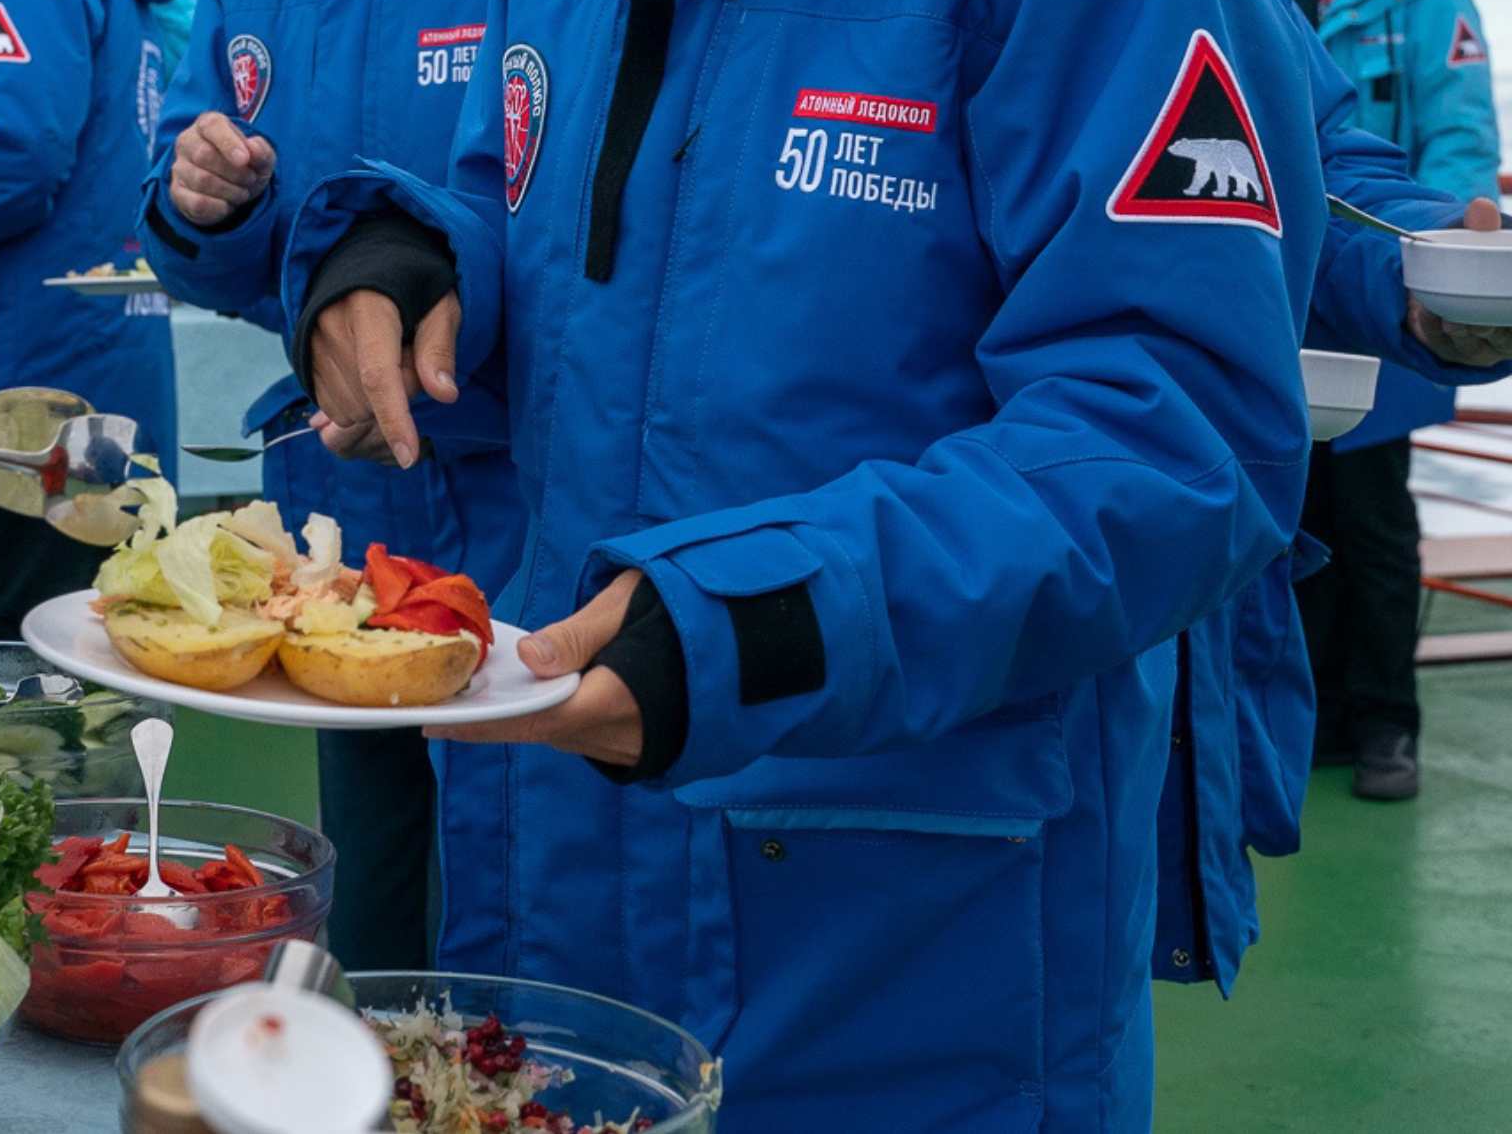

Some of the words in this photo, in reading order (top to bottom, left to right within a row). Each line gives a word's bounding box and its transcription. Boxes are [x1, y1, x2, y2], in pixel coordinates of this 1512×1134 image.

[418, 50, 448, 86] 50
[452, 46, 477, 64] ЛЕТ
[799, 95, 856, 115] АТОМНЫЙ
[857, 100, 931, 126] ЛЕДОКОЛ
[775, 127, 829, 193] 50
[834, 132, 884, 167] ЛЕТ
[829, 168, 939, 213] ПОБЕДЫ
